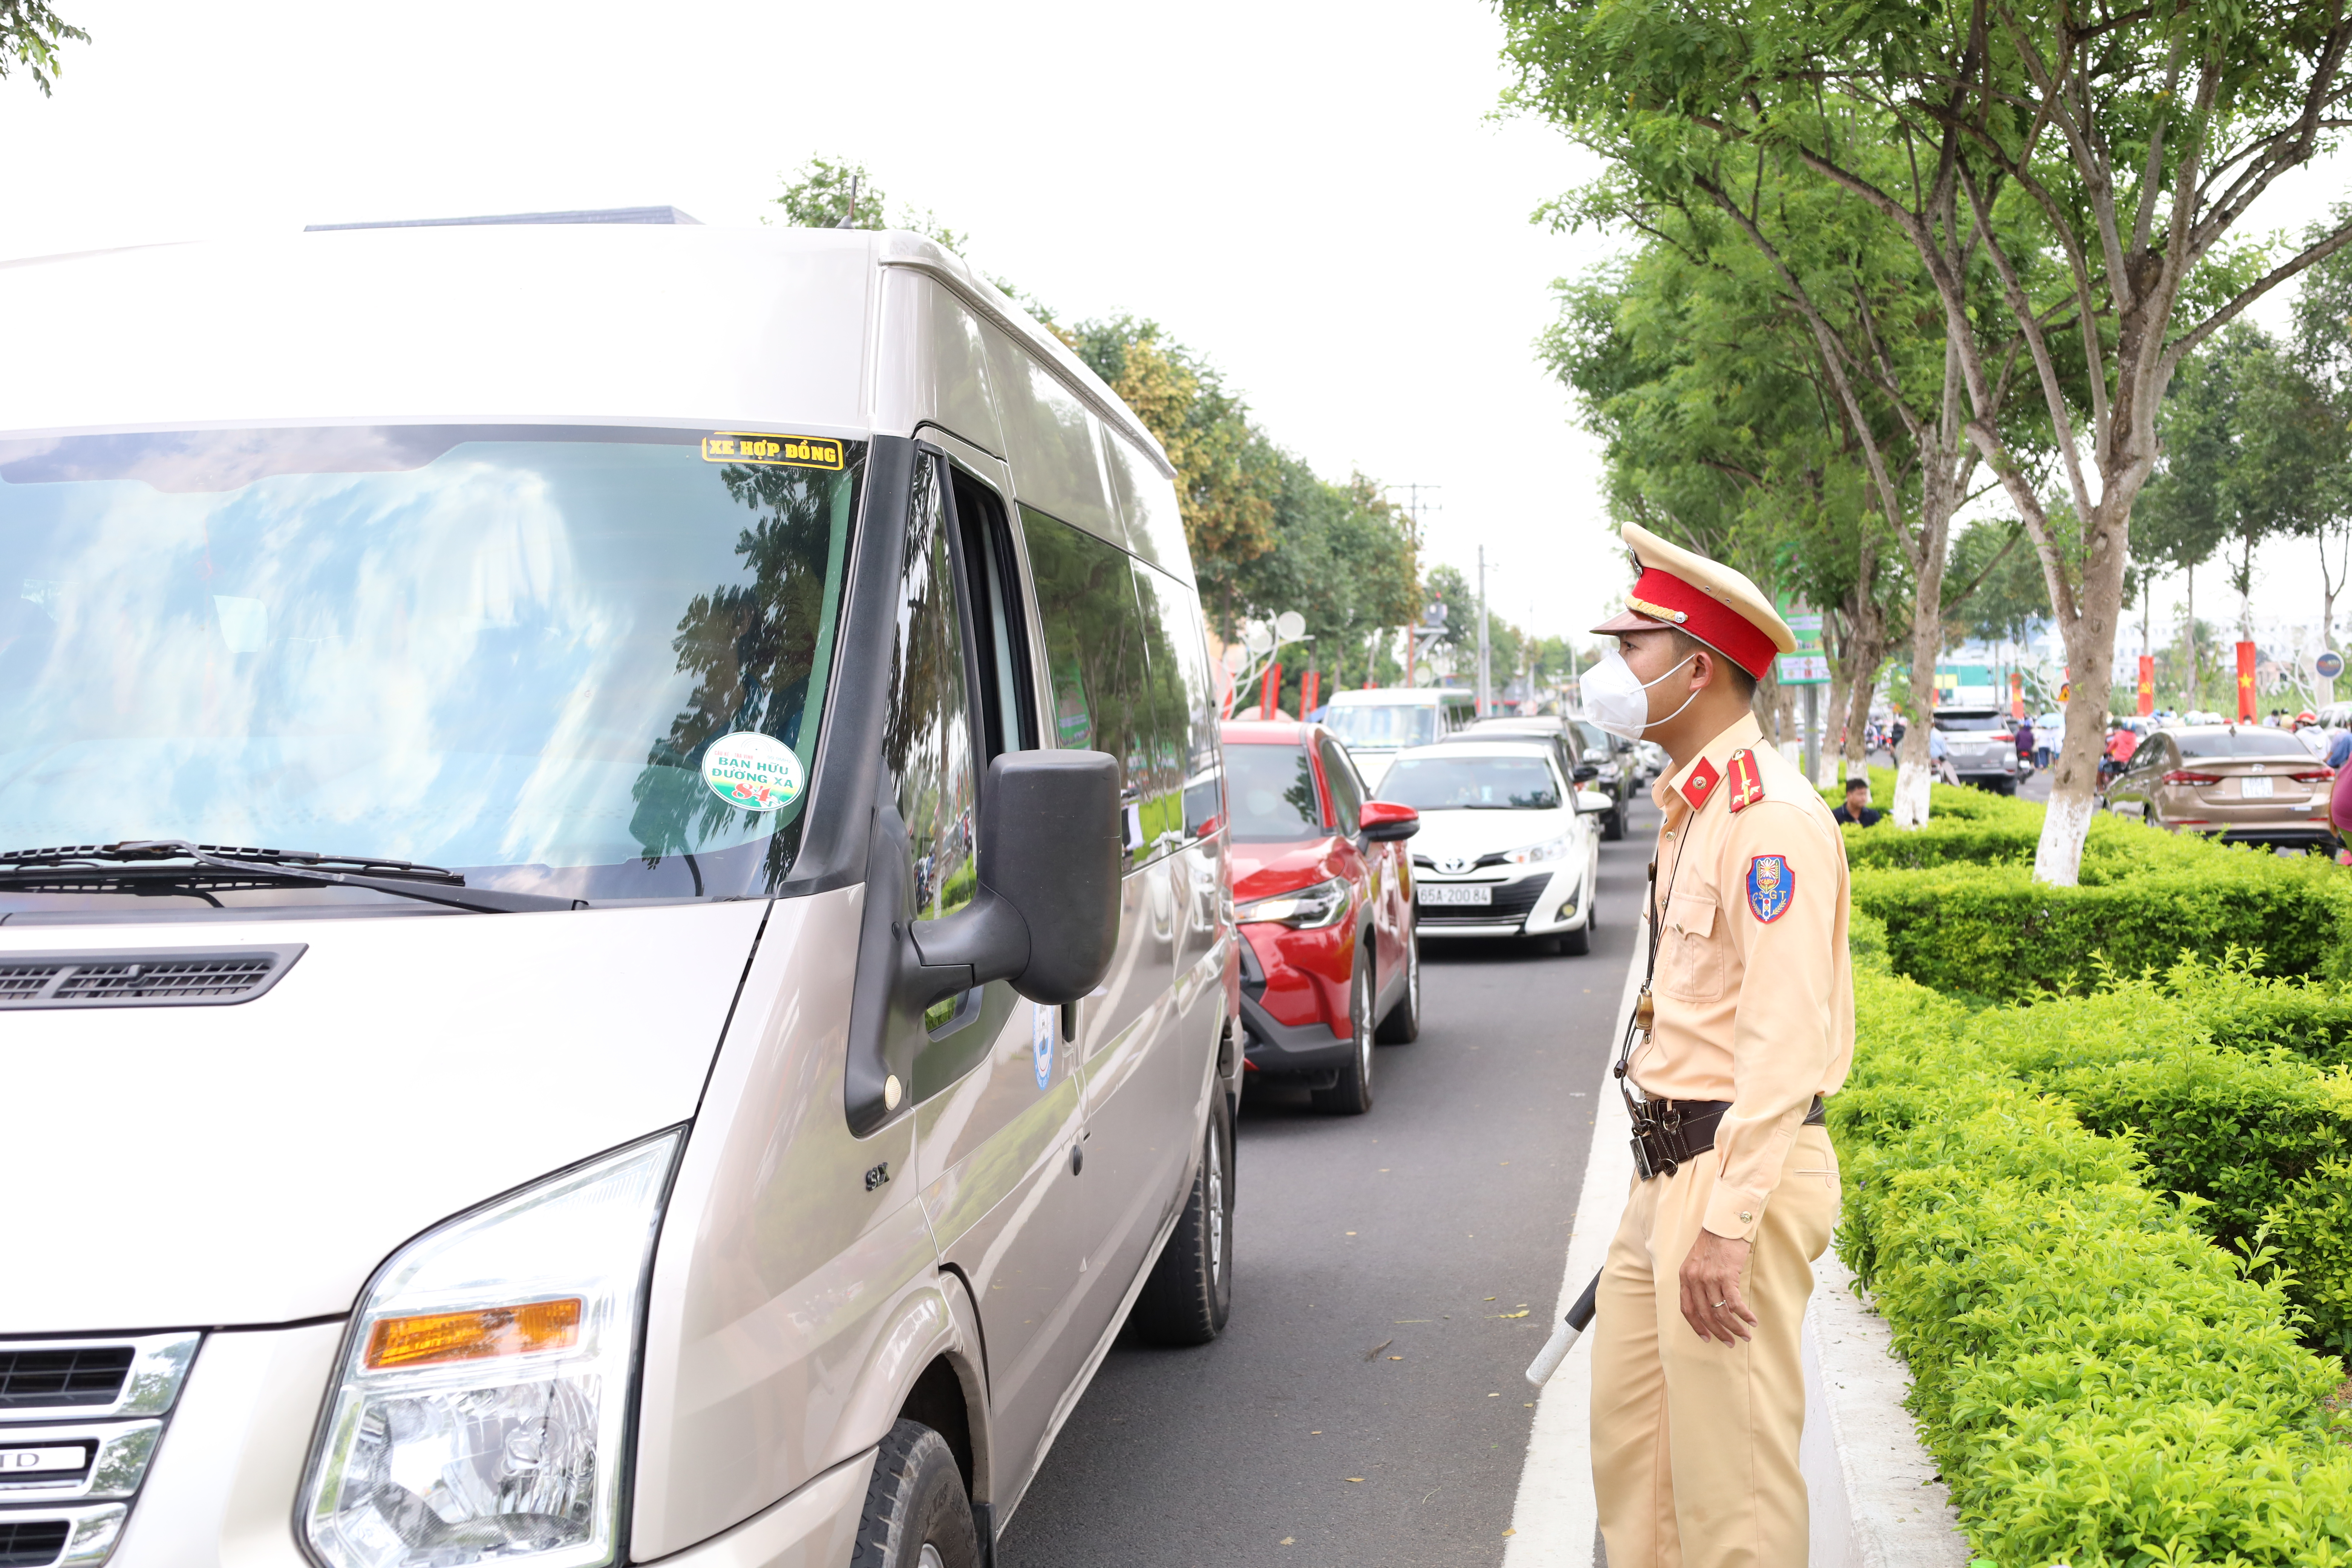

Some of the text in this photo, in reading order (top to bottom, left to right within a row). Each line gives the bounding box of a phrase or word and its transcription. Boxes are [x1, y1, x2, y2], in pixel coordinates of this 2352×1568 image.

[709, 439, 836, 462] XE HỢP ĐỒNG
[719, 757, 788, 775] BẠN HỮU
[712, 768, 793, 789] ĐƯỜNG XA
[732, 783, 772, 802] 84
[866, 1162, 890, 1191] SLX
